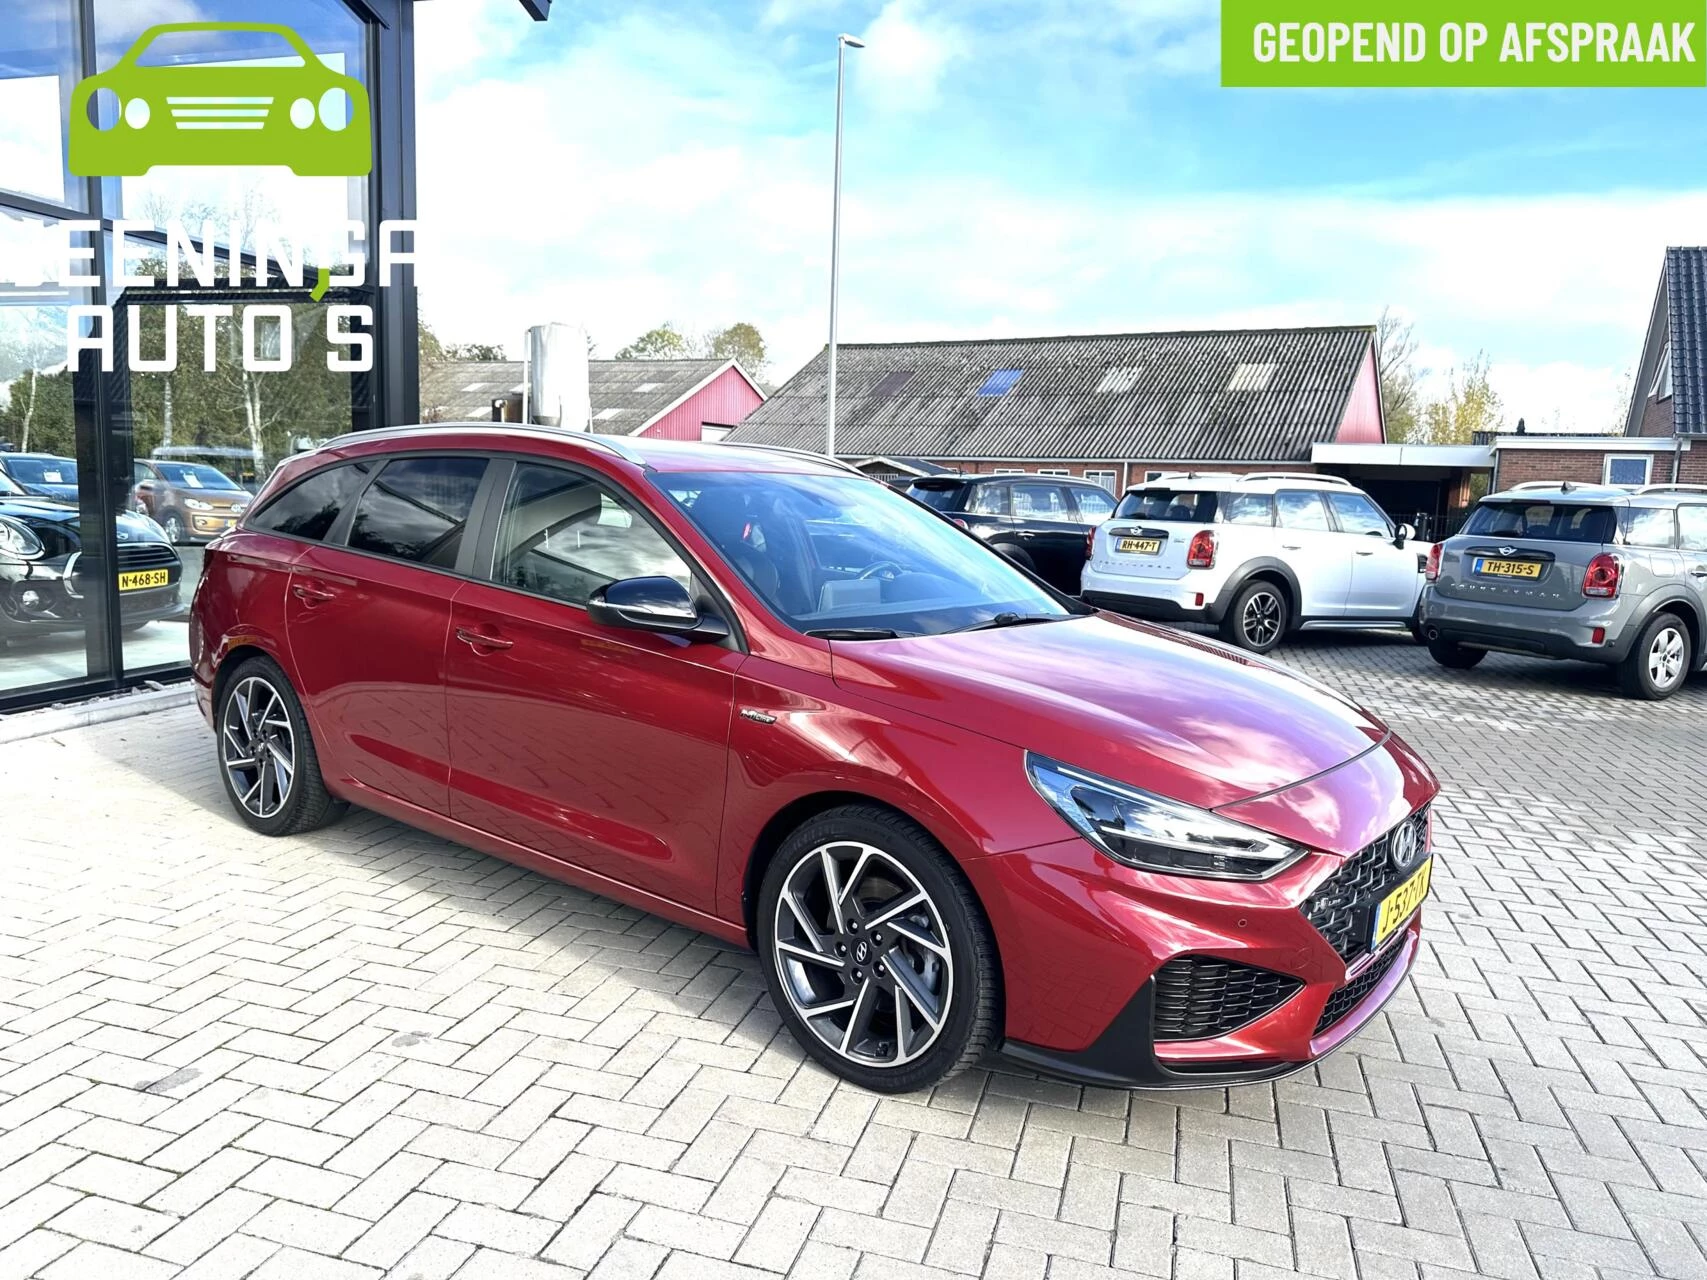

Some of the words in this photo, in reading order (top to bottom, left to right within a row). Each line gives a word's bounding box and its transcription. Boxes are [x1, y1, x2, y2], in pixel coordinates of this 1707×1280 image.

[1121, 540, 1158, 551] RH-447-T
[1486, 561, 1535, 575] TH-315-S
[121, 571, 166, 588] N-468-SH
